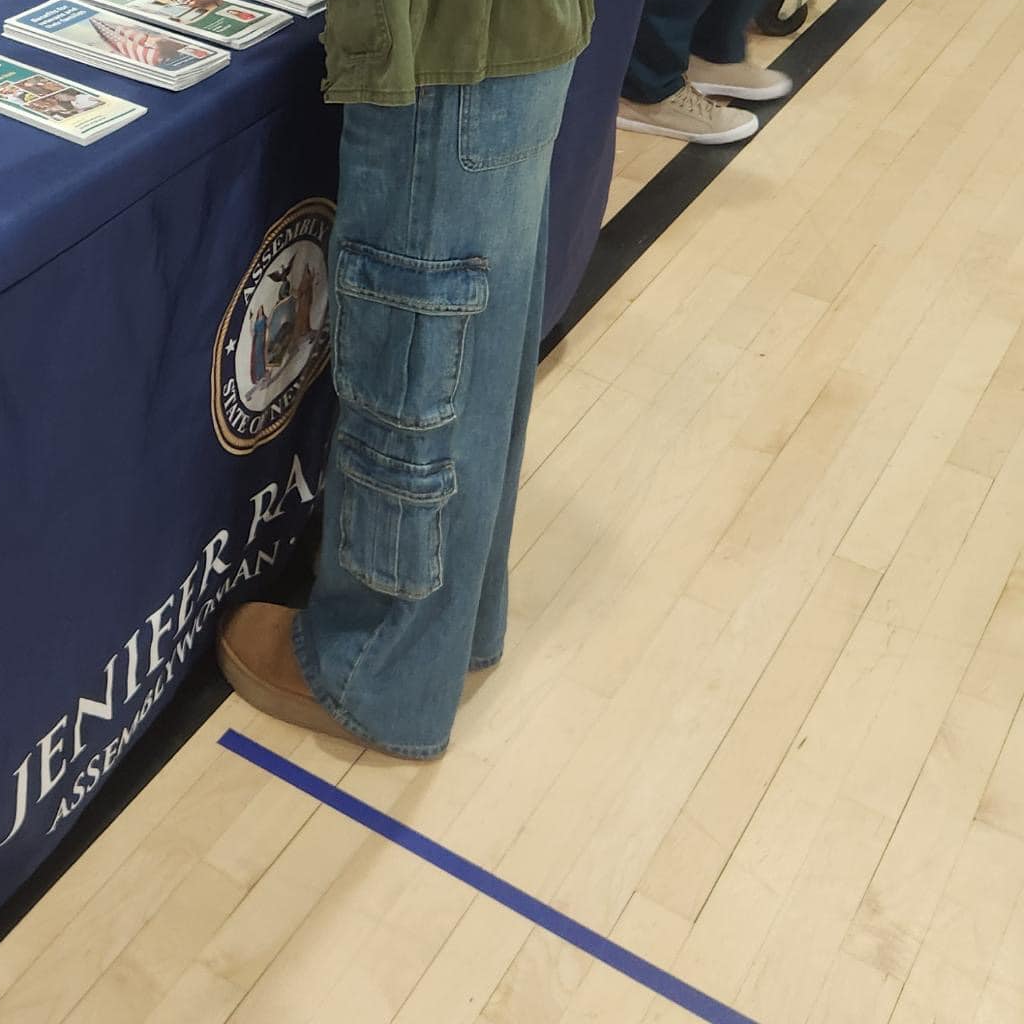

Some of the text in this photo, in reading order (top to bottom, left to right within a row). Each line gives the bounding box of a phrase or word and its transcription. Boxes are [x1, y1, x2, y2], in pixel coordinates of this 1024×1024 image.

[243, 217, 327, 306] ASSEMBLY
[223, 377, 250, 434] STATE
[47, 539, 280, 836] ASSEMBLYWOMAN
